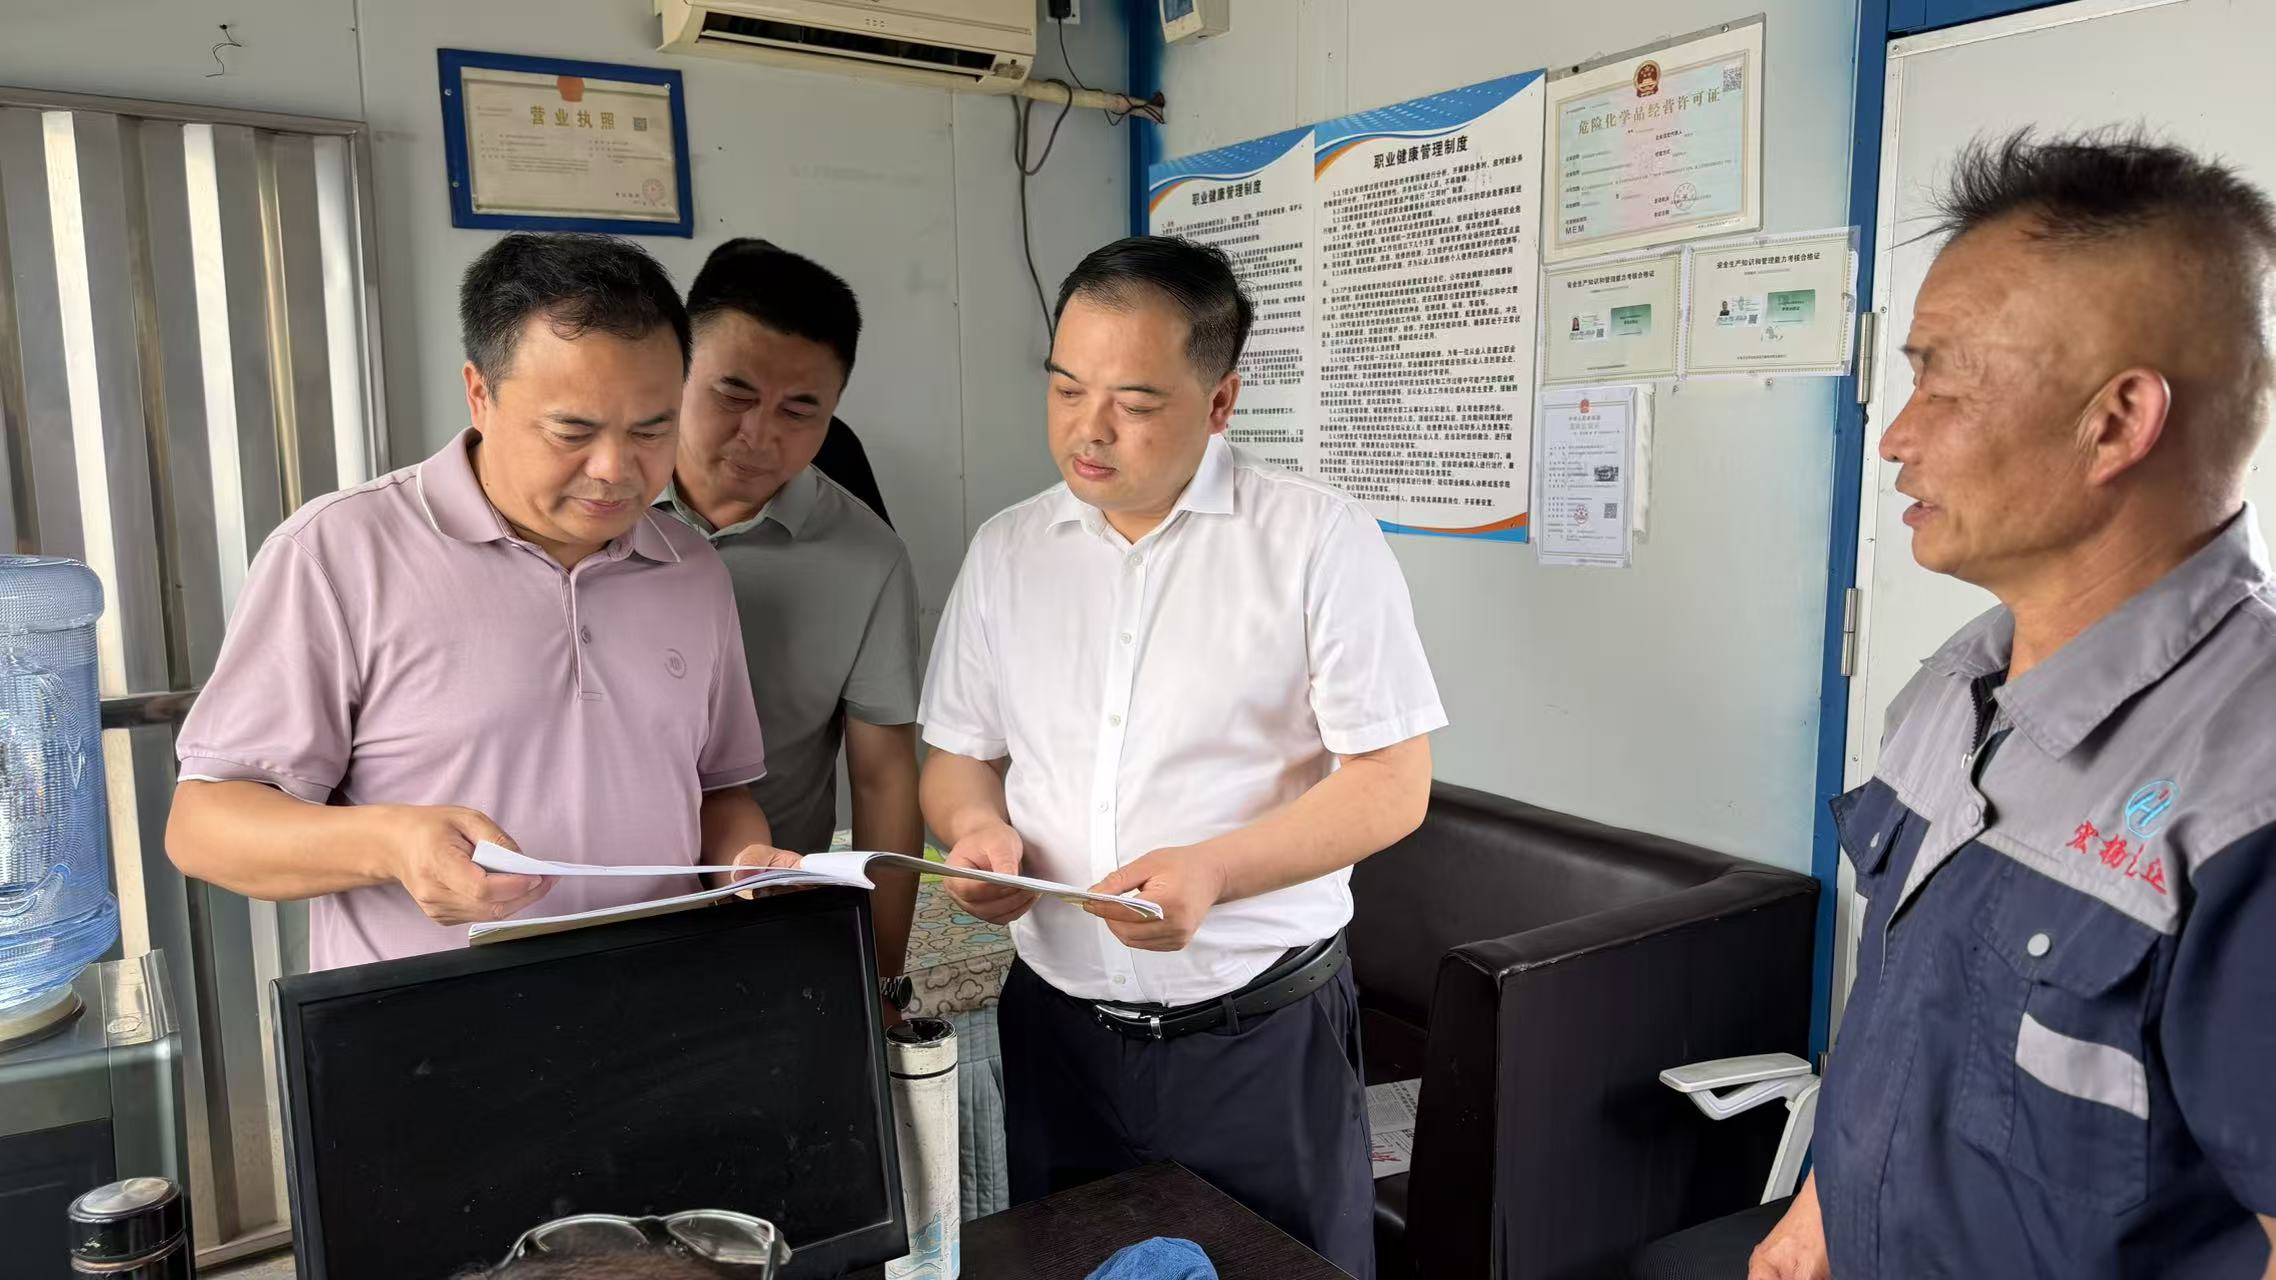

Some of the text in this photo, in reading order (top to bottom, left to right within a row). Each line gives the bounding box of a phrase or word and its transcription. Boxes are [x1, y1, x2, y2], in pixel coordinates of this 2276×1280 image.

[530, 105, 616, 130] 营业执照
[1578, 87, 1721, 135] 危险化学品经营许可证
[1373, 134, 1468, 170] 职业健康管理制度
[1192, 180, 1262, 206] 职业健康管理制度
[1566, 225, 1585, 235] MEM
[1716, 252, 1821, 269] 安全生产知识和管理能力考核合格证
